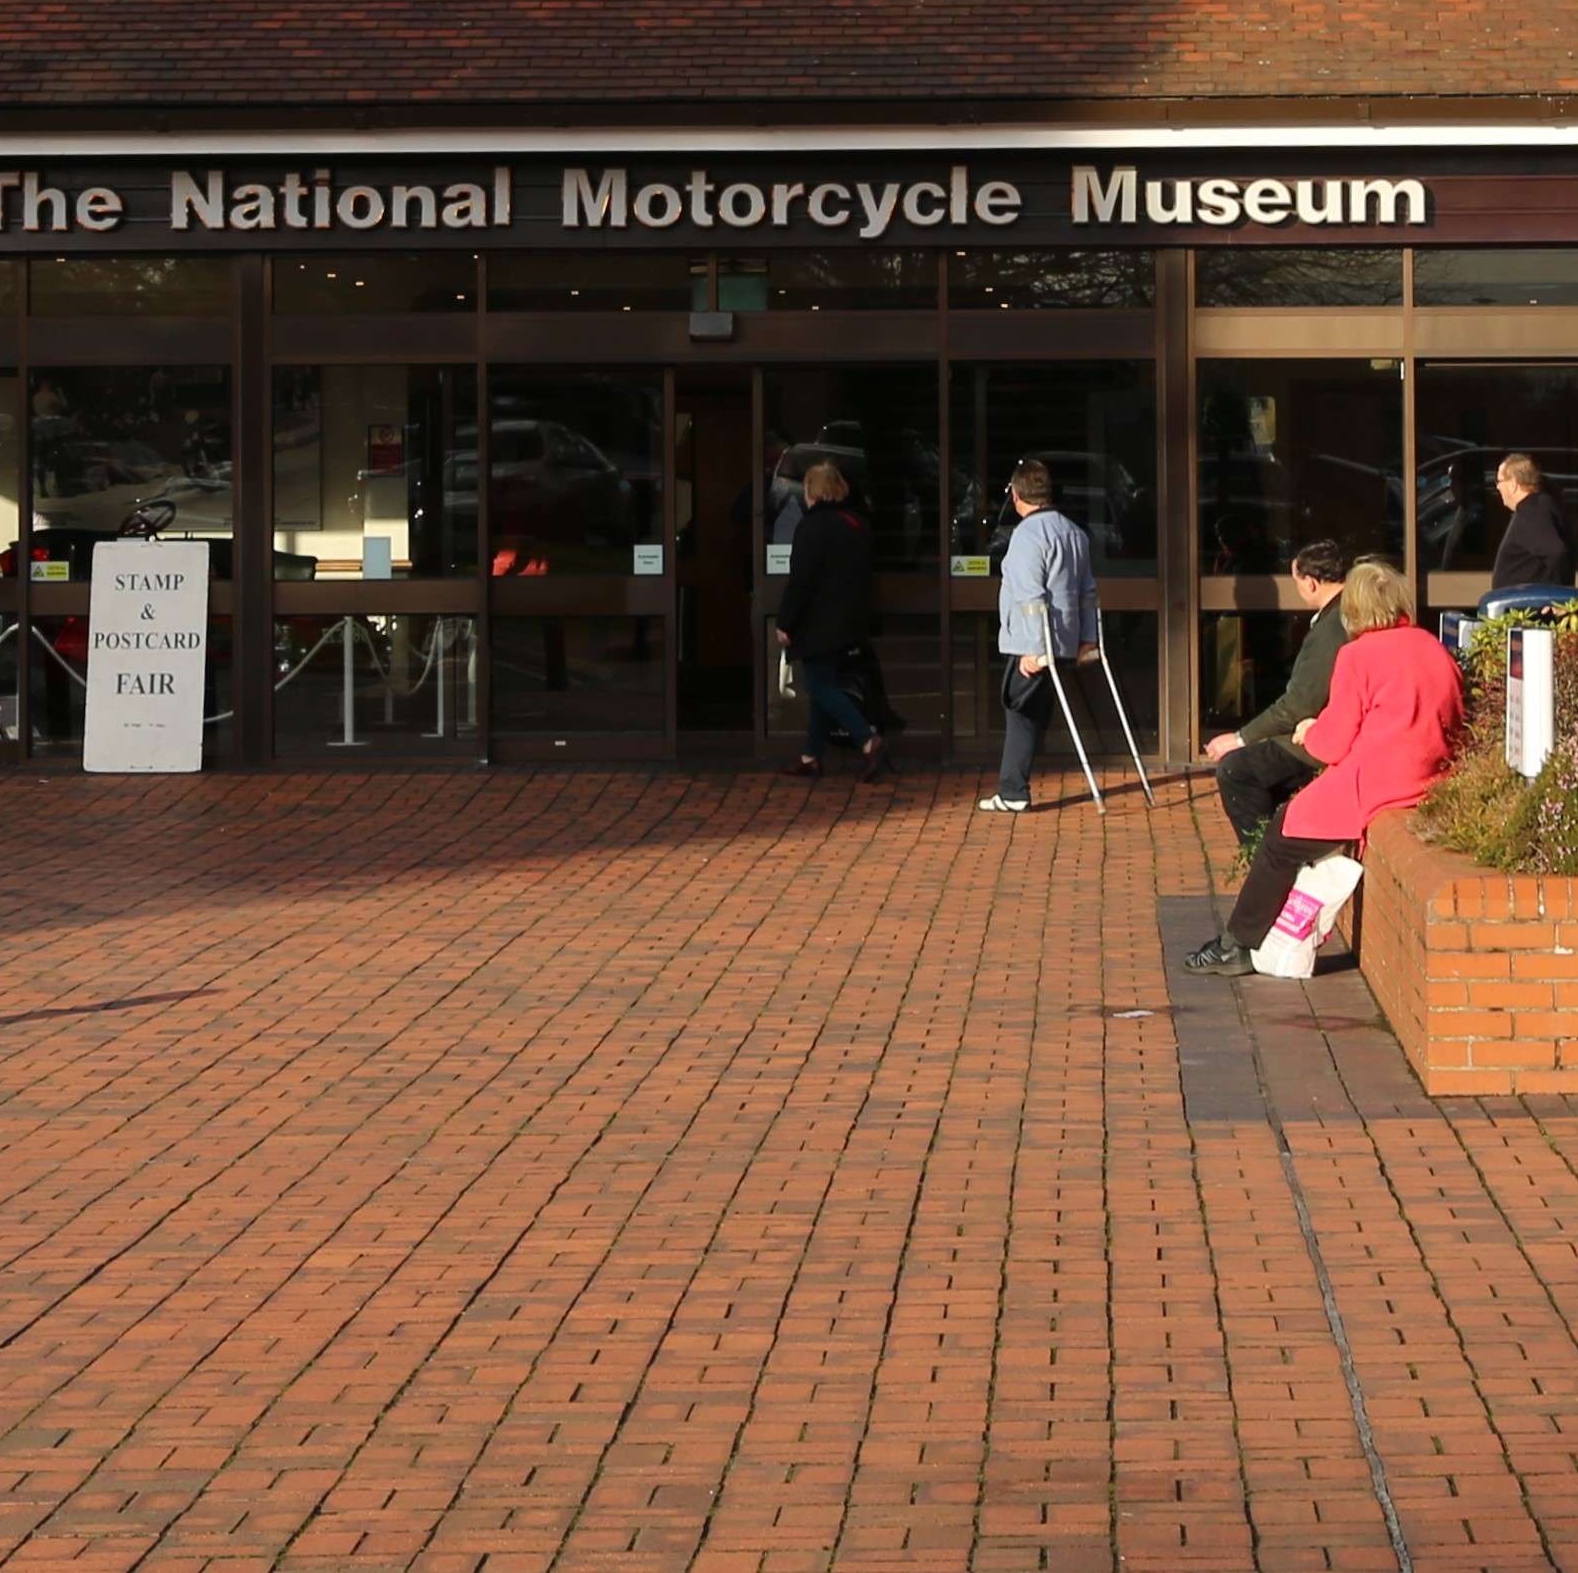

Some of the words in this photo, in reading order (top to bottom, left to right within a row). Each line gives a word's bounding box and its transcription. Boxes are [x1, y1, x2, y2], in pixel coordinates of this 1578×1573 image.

[170, 166, 511, 230] National
[561, 165, 1021, 238] Motorcycle
[1071, 165, 1425, 225] Museum
[115, 574, 184, 591] STAMP
[140, 603, 157, 620] &
[94, 632, 201, 650] POSTCARD
[116, 673, 175, 695] FAIR
